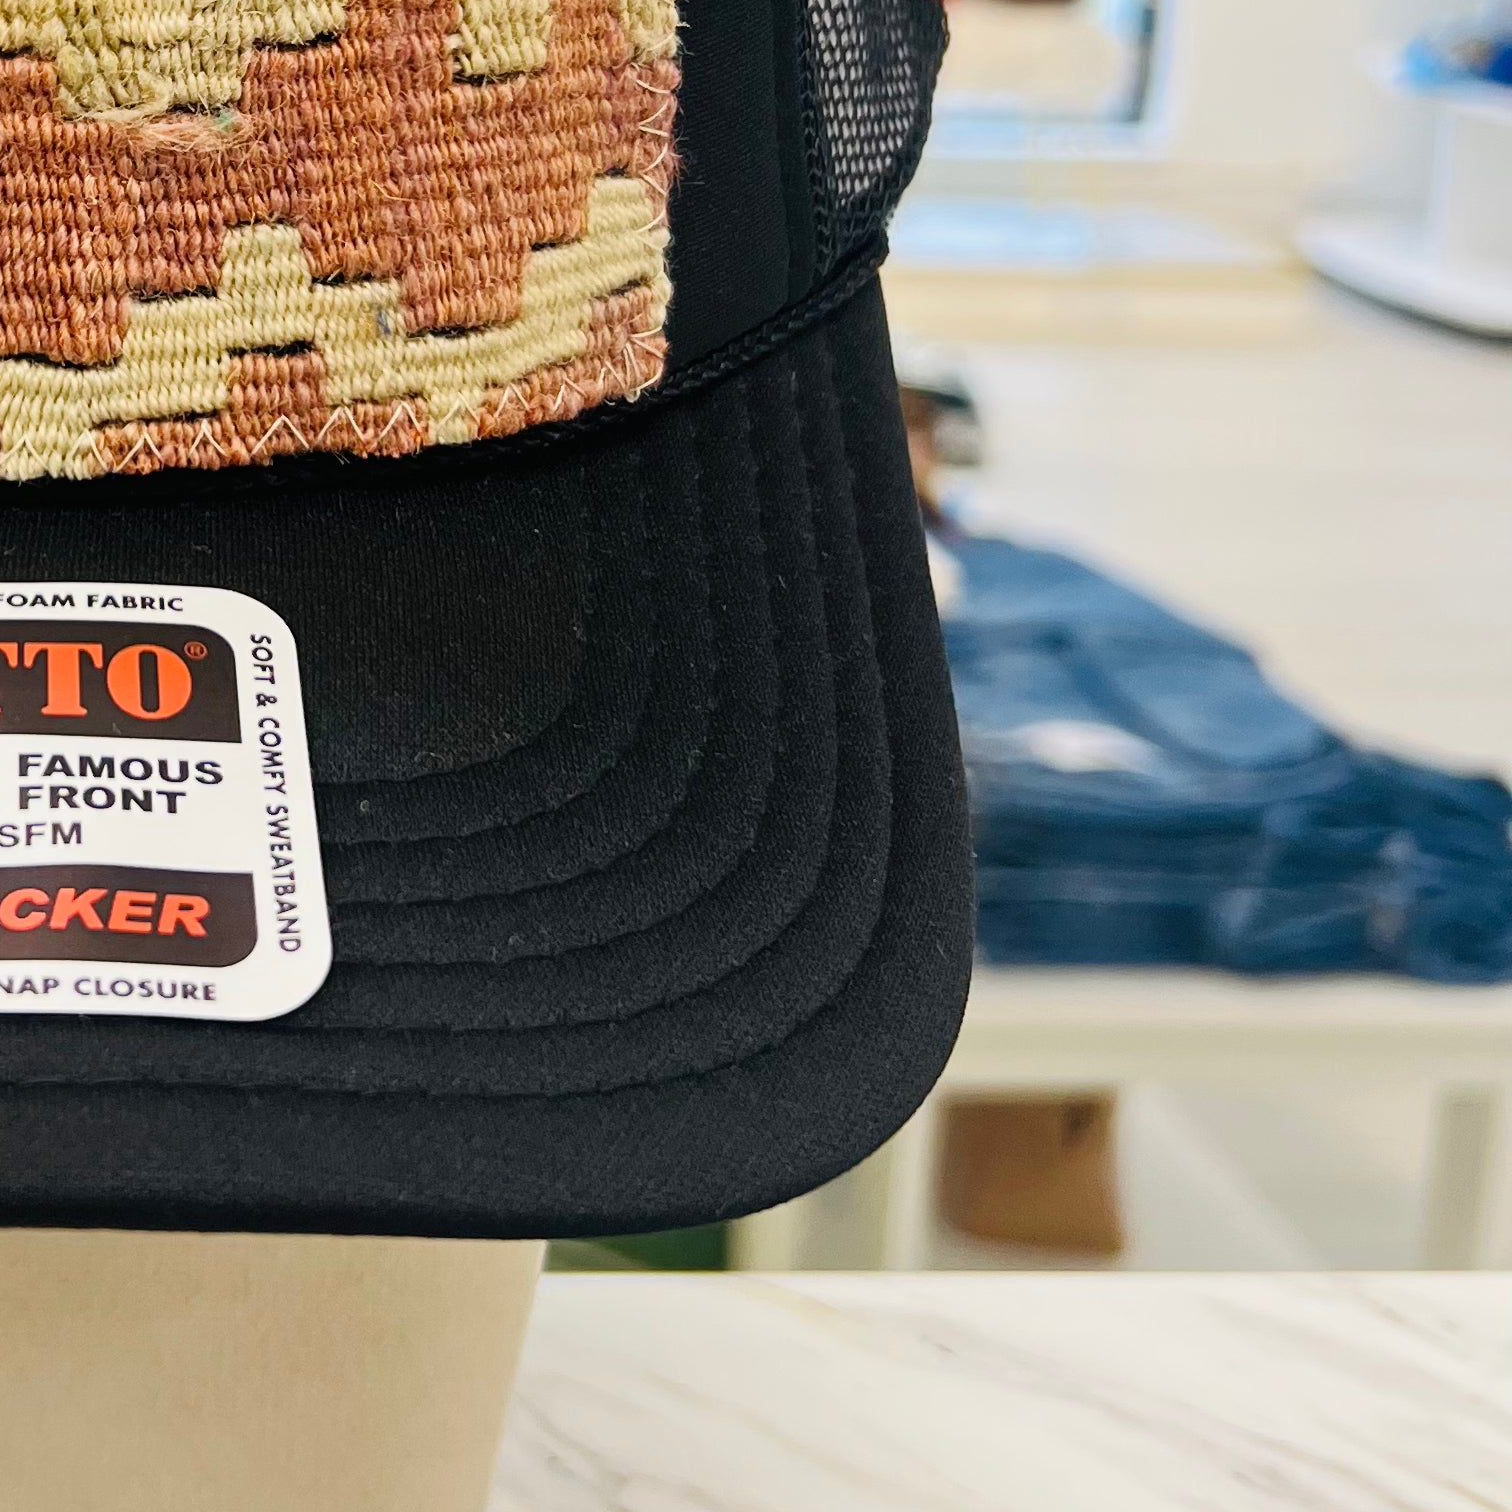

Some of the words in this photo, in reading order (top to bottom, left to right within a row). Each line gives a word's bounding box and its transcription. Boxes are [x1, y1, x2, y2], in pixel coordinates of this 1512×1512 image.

[86, 594, 185, 612] FABRIC
[249, 633, 277, 685] SOFT
[256, 693, 270, 708] &
[18, 753, 224, 785] FAMOUS
[256, 716, 288, 796] COMFY
[18, 785, 186, 814] FRONT
[264, 803, 302, 953] SWEATBAND
[74, 977, 217, 1001] CLOSURE
